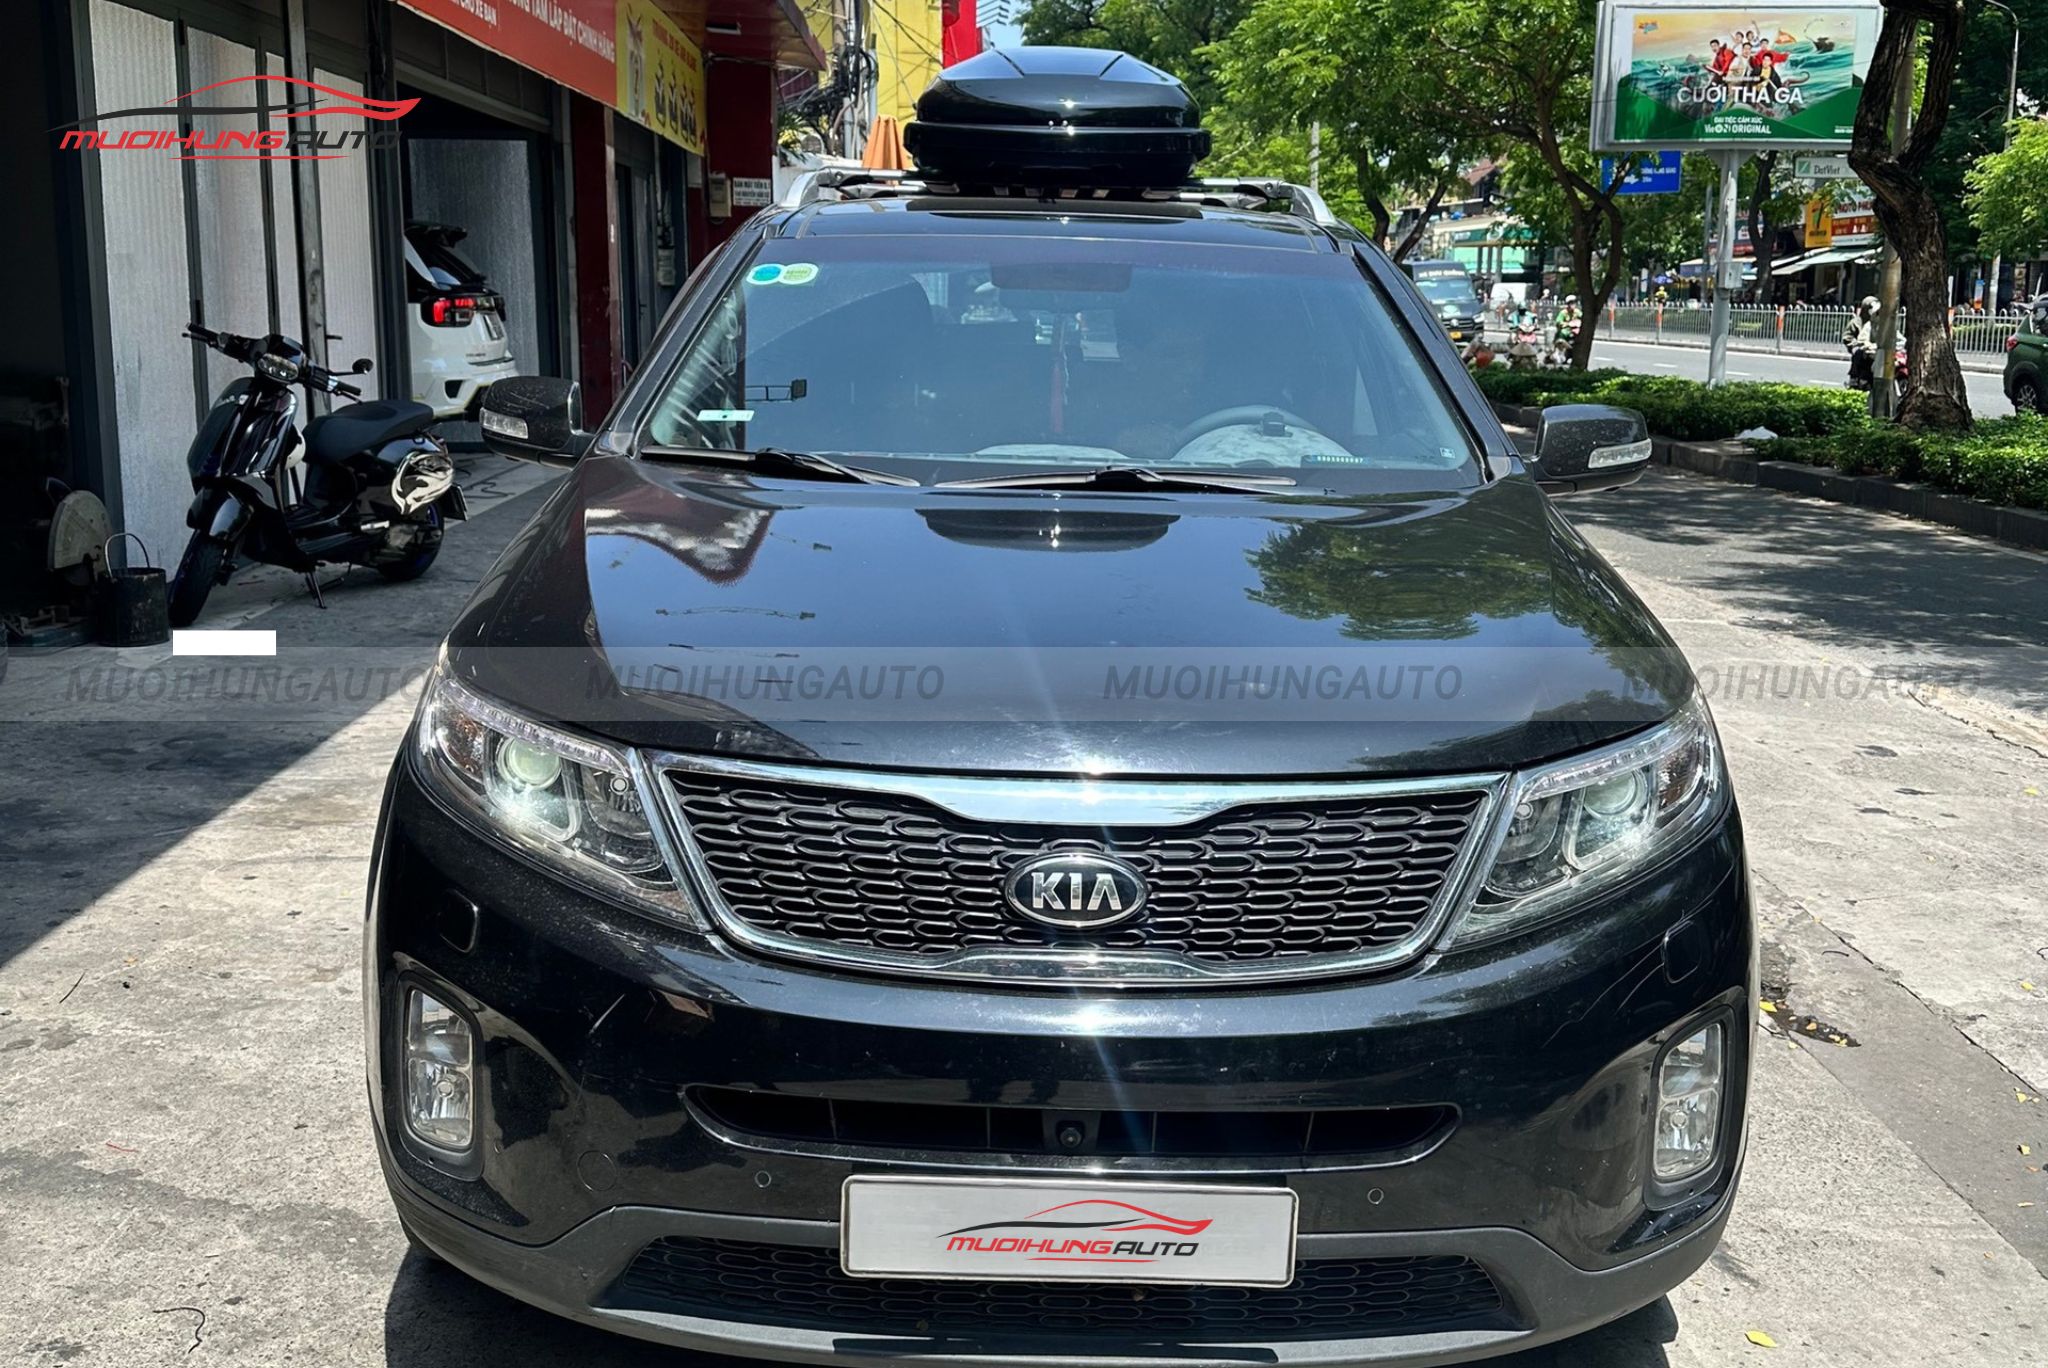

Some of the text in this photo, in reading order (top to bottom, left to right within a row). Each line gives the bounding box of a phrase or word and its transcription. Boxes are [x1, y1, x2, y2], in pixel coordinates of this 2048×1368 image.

[1774, 86, 1804, 104] GA
[1732, 123, 1772, 134] ORIGINAL
[1031, 872, 1124, 911] KIA
